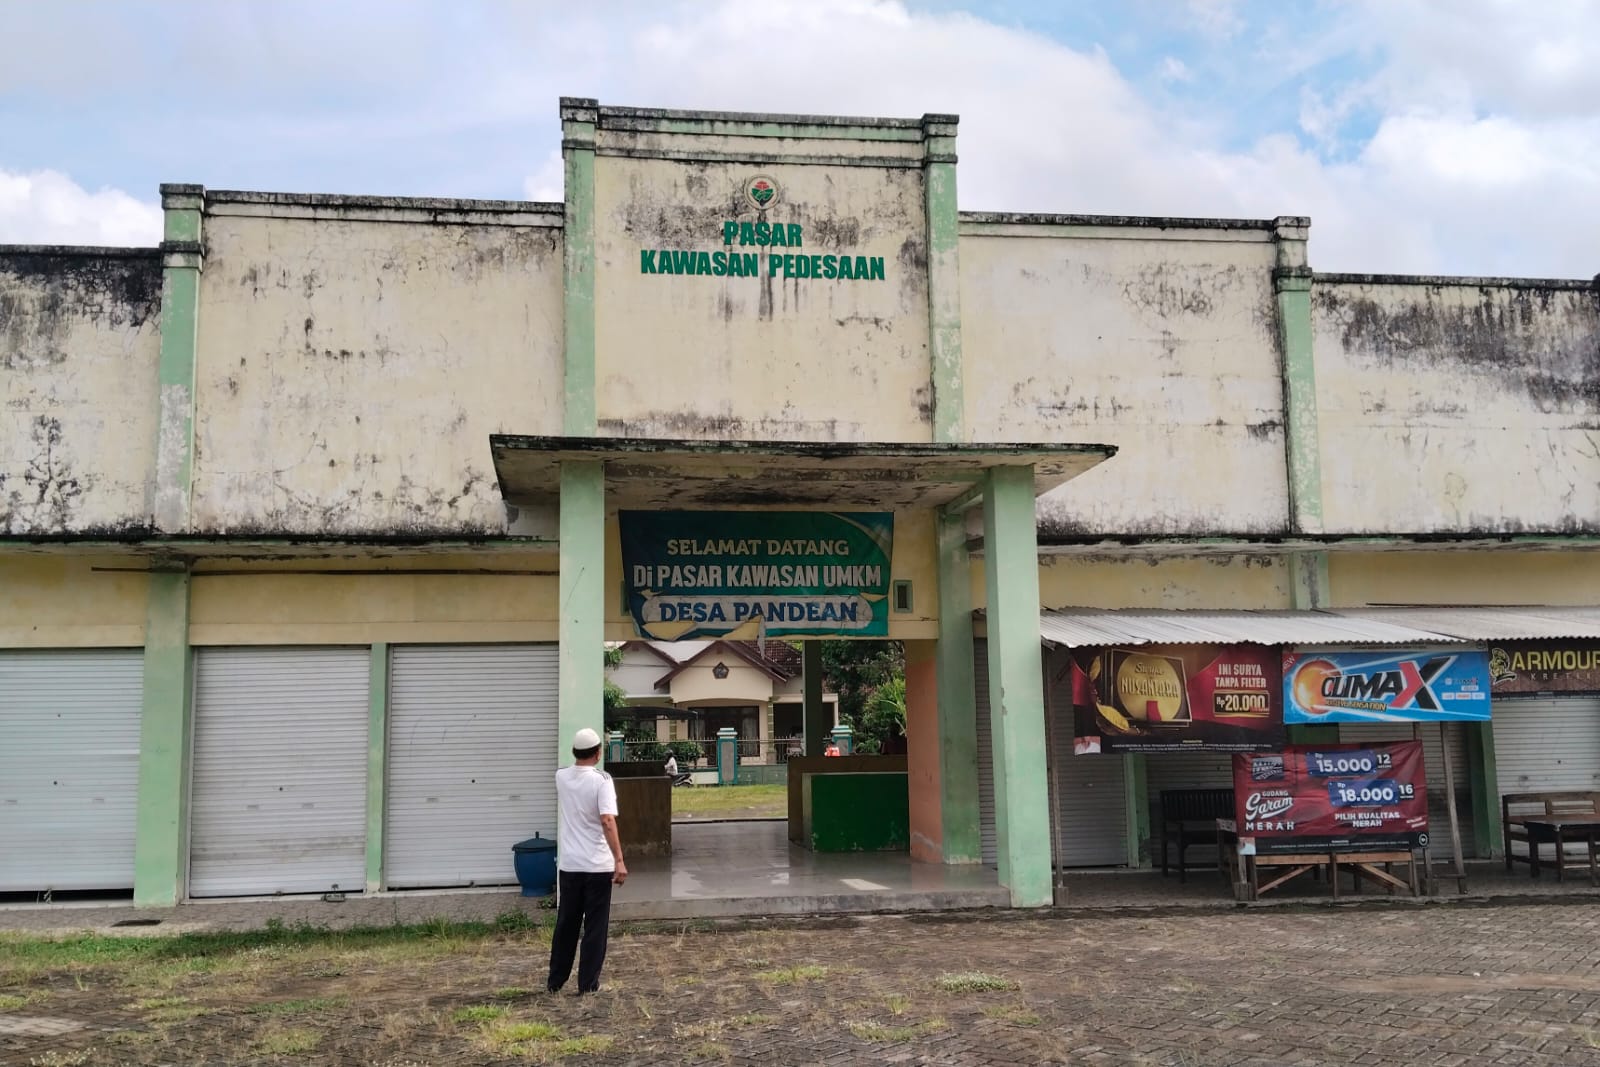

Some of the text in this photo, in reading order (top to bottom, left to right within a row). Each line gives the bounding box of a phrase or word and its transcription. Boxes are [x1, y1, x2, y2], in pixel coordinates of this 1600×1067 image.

[723, 221, 803, 247] PASAR
[640, 249, 886, 281] KAWASAN PEDESAAN
[667, 539, 849, 556] SELAMAT DATANG
[633, 564, 881, 588] Di PASAR KAWASAN UMKM
[659, 602, 858, 622] DESA PANDEAN
[1218, 663, 1262, 676] INI SURYA
[1120, 677, 1179, 698] NUSANTARA
[1215, 677, 1267, 688] TANPA FILTER
[1320, 656, 1453, 710] CLIMAX
[1316, 758, 1372, 773] 15.000
[1377, 754, 1391, 764] 12
[1338, 788, 1394, 802] 18.000
[1399, 784, 1413, 794] 16
[1245, 792, 1294, 820] Garam
[1334, 811, 1401, 821] PILIH KUALITAS
[1245, 821, 1295, 831] MERAH
[1352, 820, 1382, 828] MERAH
